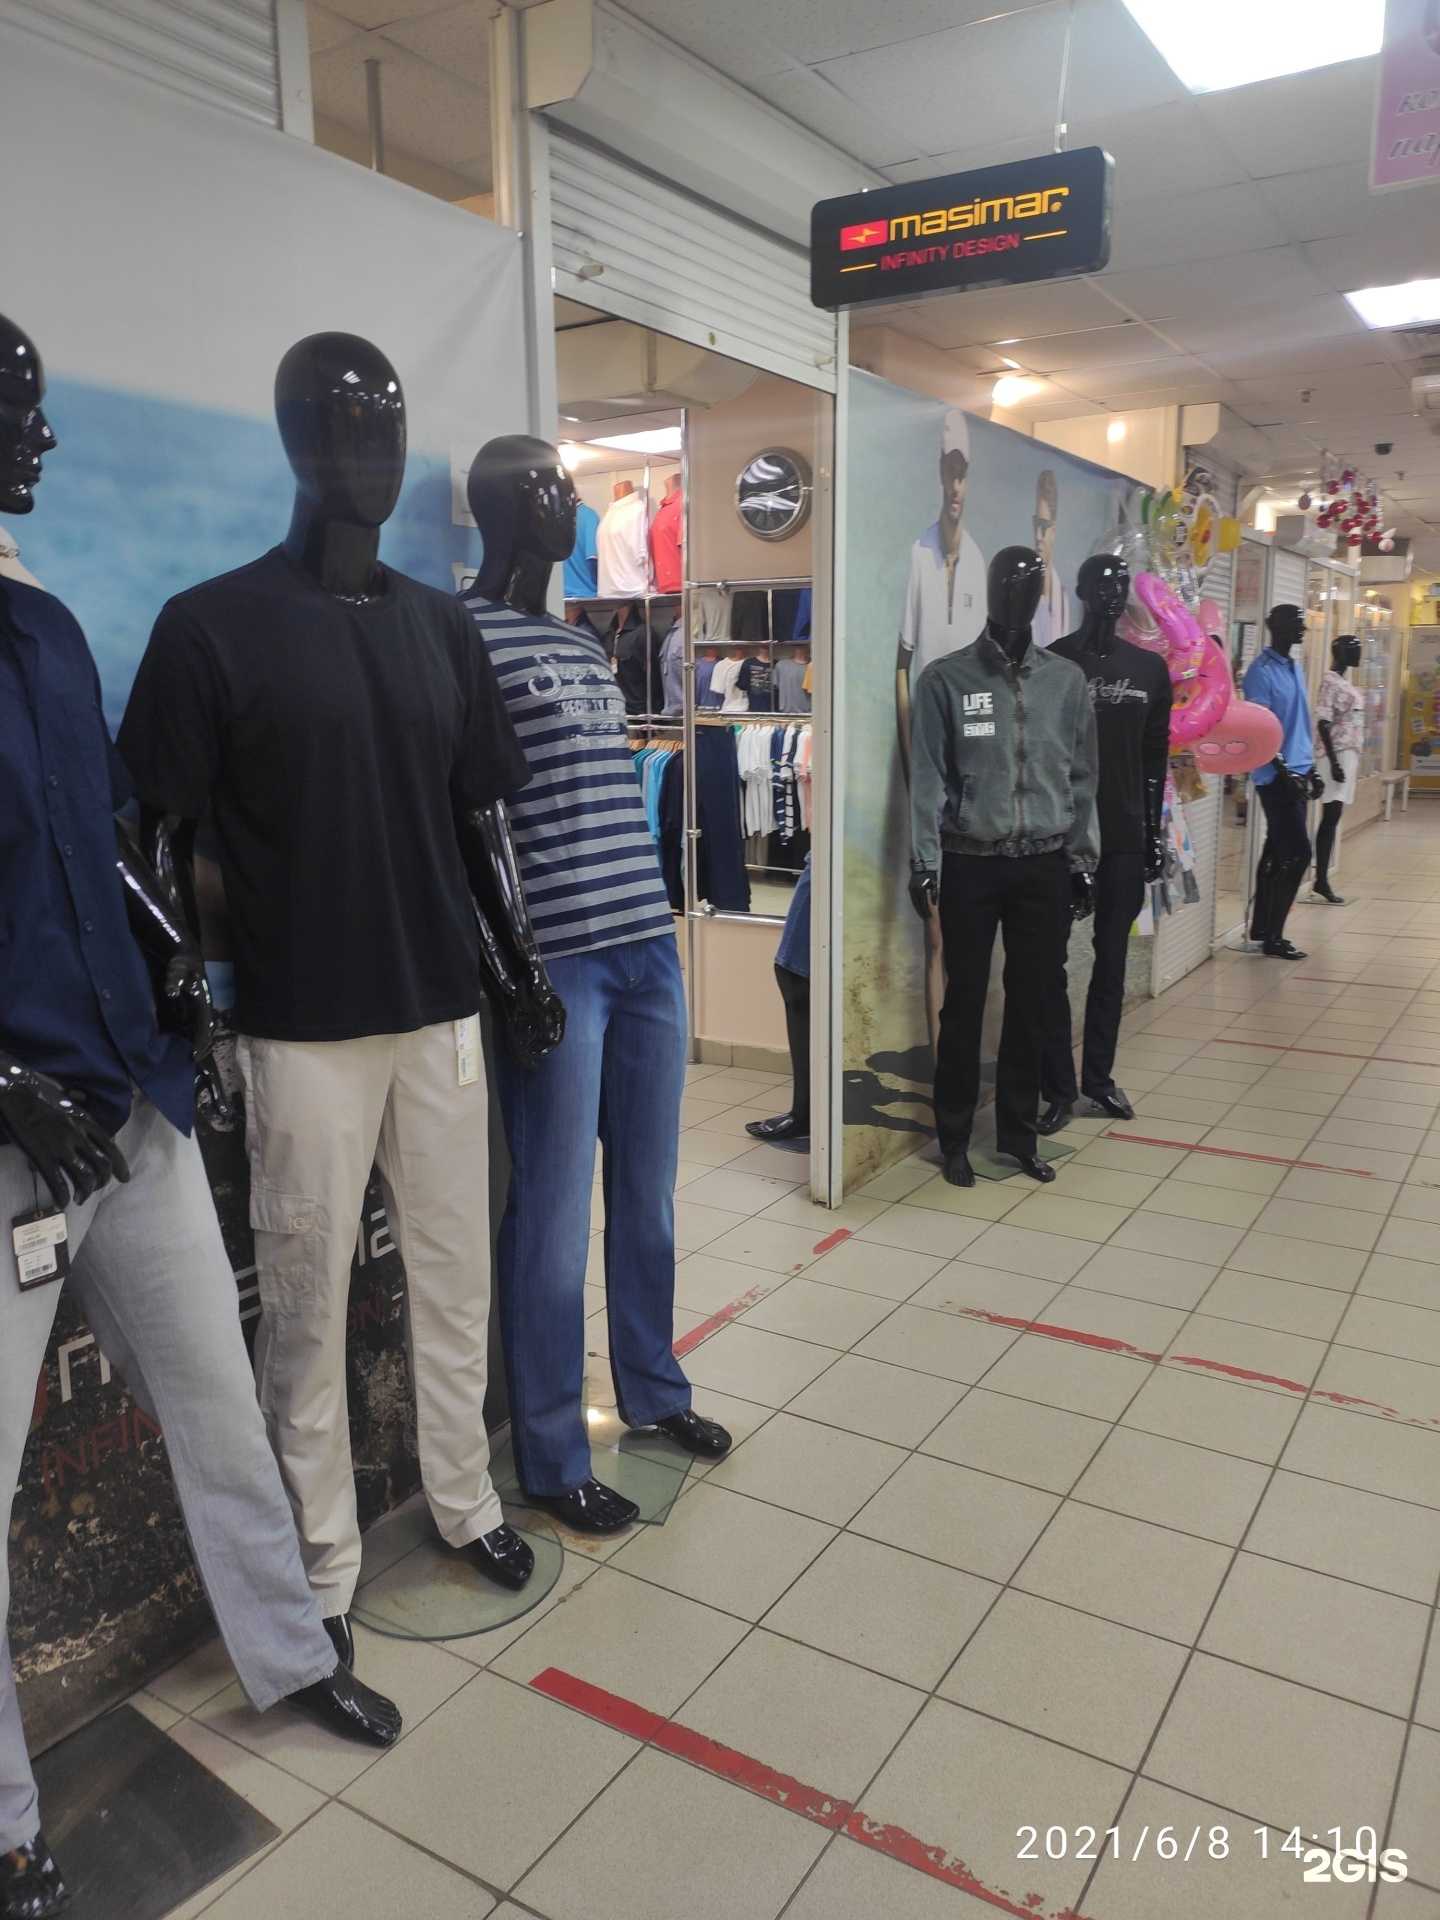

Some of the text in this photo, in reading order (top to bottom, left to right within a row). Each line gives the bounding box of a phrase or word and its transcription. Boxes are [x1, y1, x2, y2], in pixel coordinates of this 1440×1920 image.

[881, 233, 1019, 270] INFINITY DESIGN
[963, 692, 993, 711] LIFE
